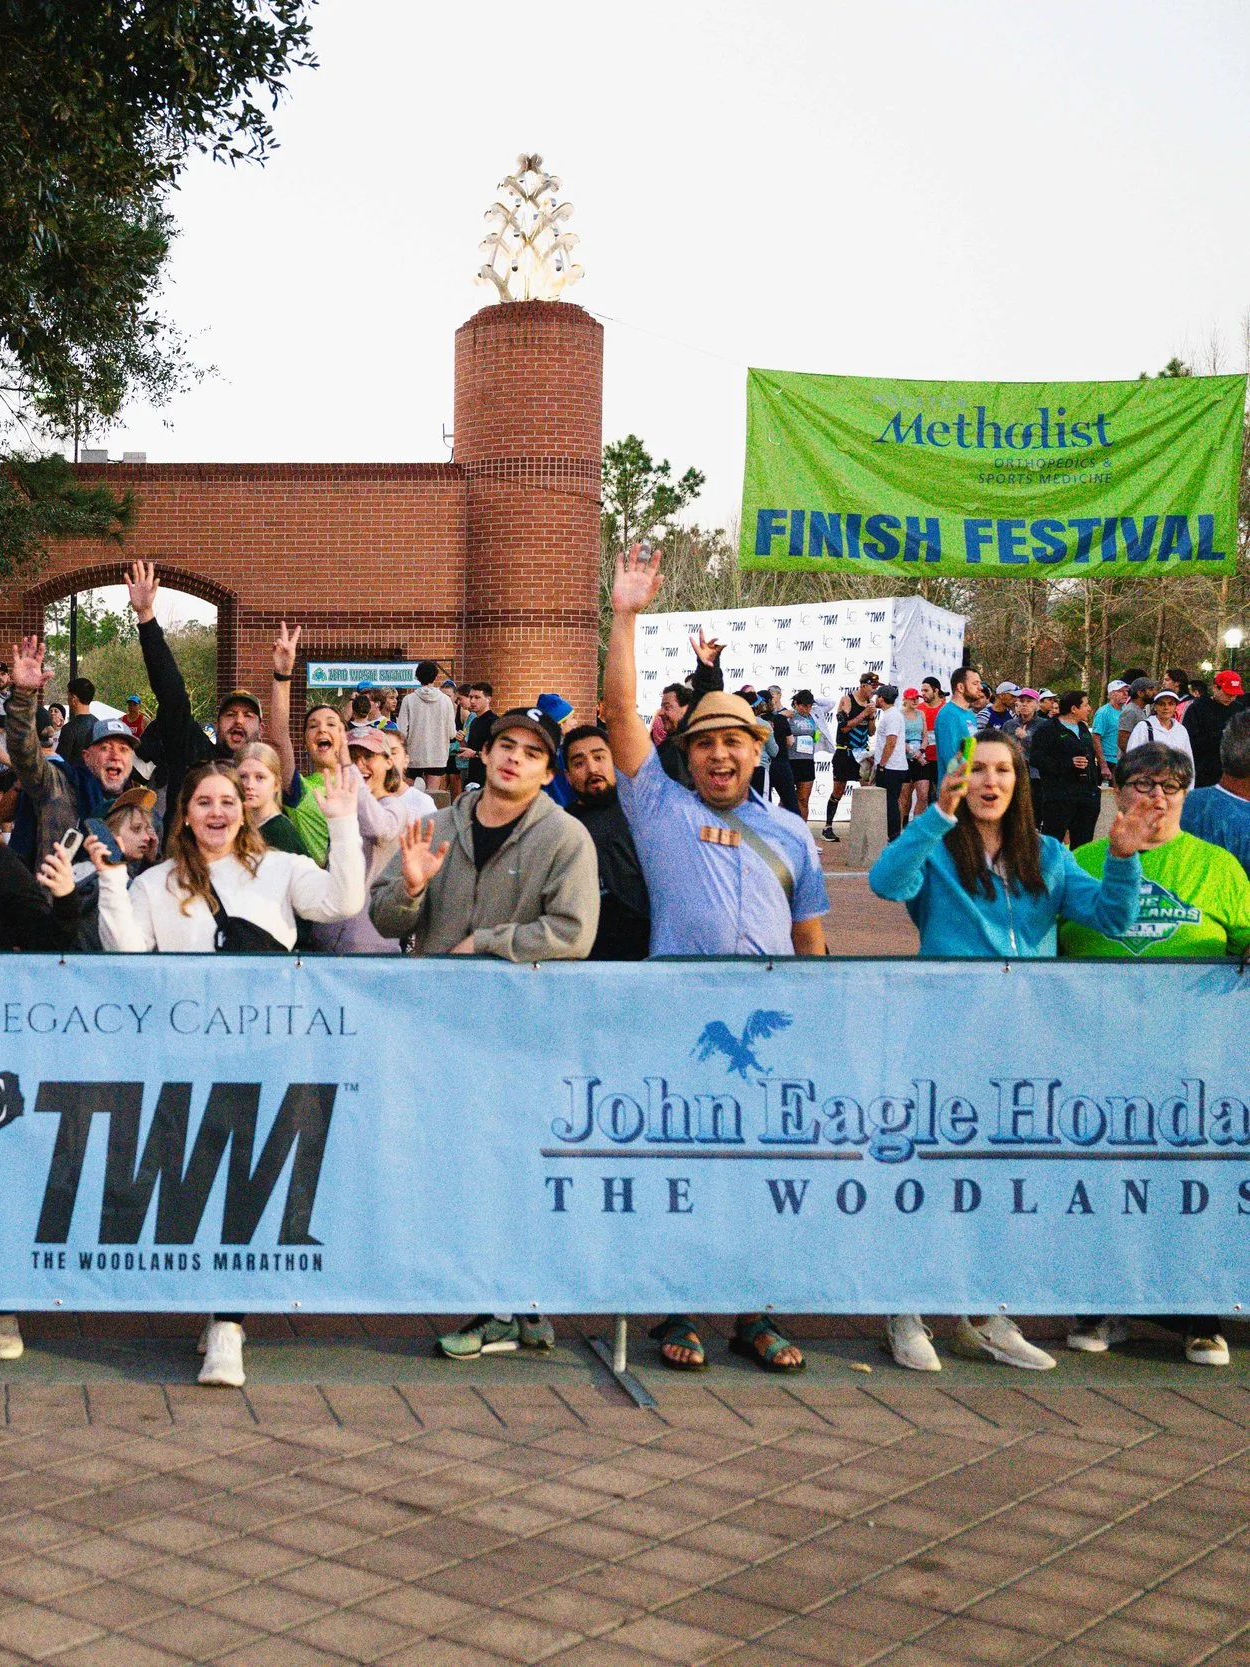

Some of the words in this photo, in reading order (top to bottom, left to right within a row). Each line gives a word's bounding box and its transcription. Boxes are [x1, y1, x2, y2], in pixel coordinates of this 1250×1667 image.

[873, 405, 1115, 450] Methodist
[978, 473, 1032, 484] SPORTS
[1039, 473, 1113, 484] MEDICINE
[994, 457, 1096, 469] ORTHOPEDICS
[1102, 457, 1113, 468] &
[754, 509, 942, 563] FINISH
[964, 513, 1226, 565] FESTIVAL
[169, 999, 357, 1036] CAPITAL
[551, 1076, 744, 1145] John
[758, 1077, 978, 1164] Eagle
[989, 1077, 1250, 1147] Honda
[34, 1081, 339, 1245] TWM
[546, 1177, 695, 1215] THE
[32, 1251, 67, 1270] THE
[79, 1251, 201, 1271] WOODLANDS
[214, 1252, 323, 1272] MARATHON
